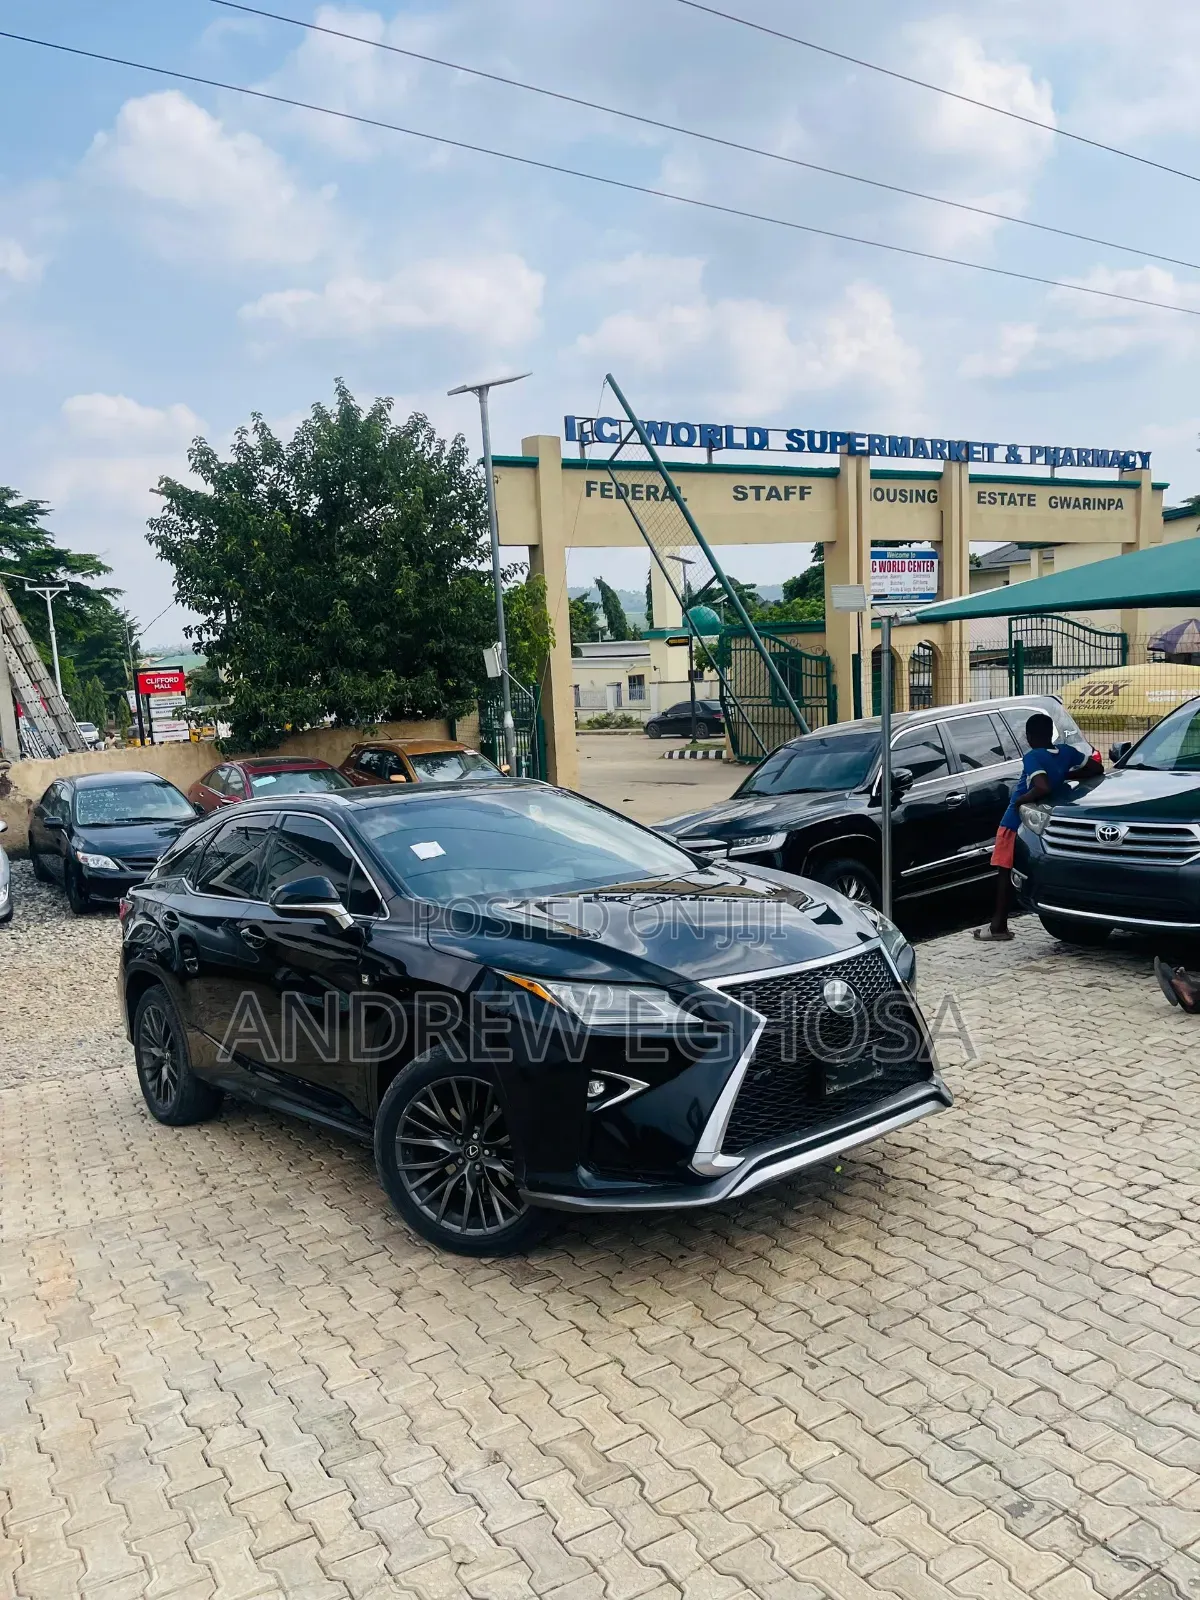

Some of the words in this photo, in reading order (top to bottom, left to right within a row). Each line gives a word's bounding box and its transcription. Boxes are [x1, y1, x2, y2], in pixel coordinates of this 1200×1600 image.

[638, 420, 769, 450] WORLD
[785, 428, 999, 463] SUPERMARKET
[1005, 445, 1023, 464] &
[1030, 445, 1152, 470] PHARMACY
[732, 485, 813, 501] STAFF
[870, 486, 938, 504] OUSING
[977, 490, 1037, 508] ESTATE
[1048, 495, 1124, 511] GWARINPA
[886, 551, 910, 559] Welcome
[878, 560, 906, 573] WORLD
[907, 560, 935, 573] CENTER
[1079, 684, 1129, 697] 10X
